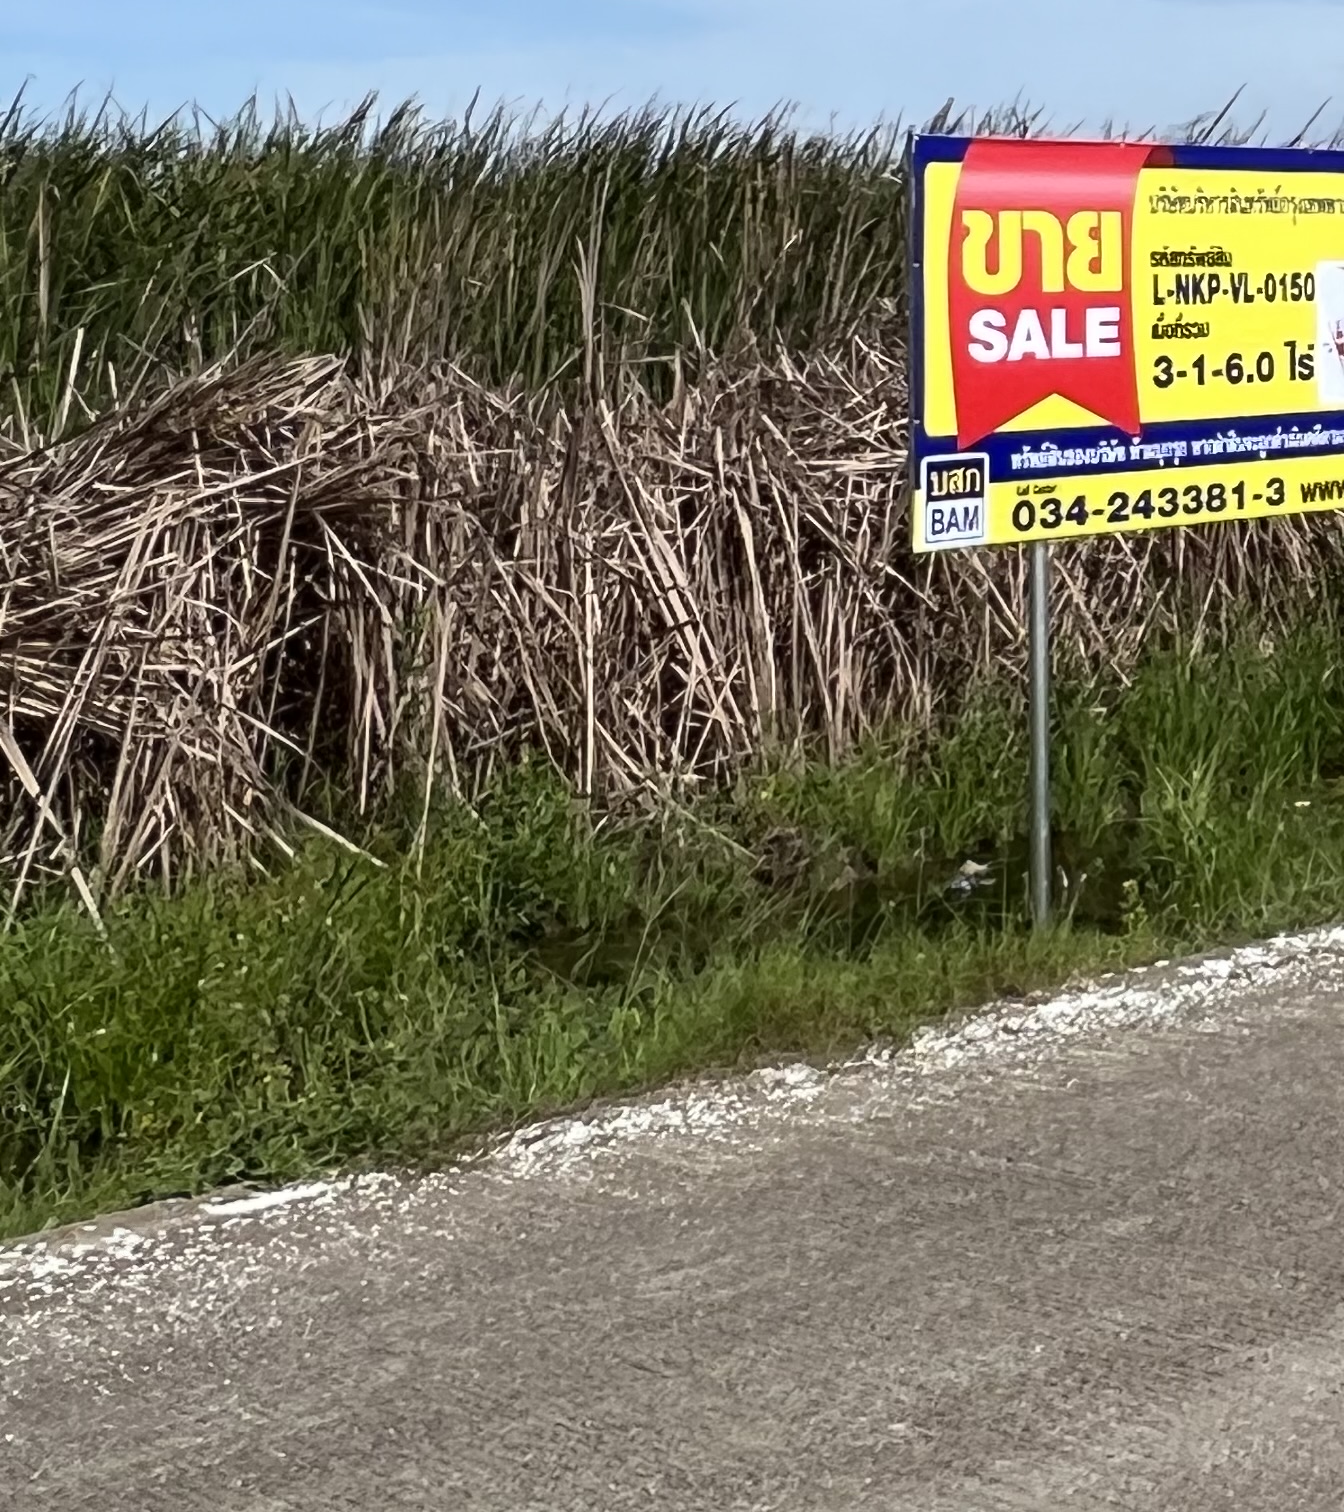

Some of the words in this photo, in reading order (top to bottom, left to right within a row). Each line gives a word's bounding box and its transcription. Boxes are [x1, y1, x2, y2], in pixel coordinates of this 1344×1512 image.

[961, 209, 1122, 295] ขาย
[1152, 272, 1316, 305] L-NKP-VL-0150
[967, 306, 1121, 362] SALE
[1152, 351, 1275, 388] 3-1-6.0
[930, 505, 980, 537] BAM
[1012, 477, 1286, 531] 034-243381-3
